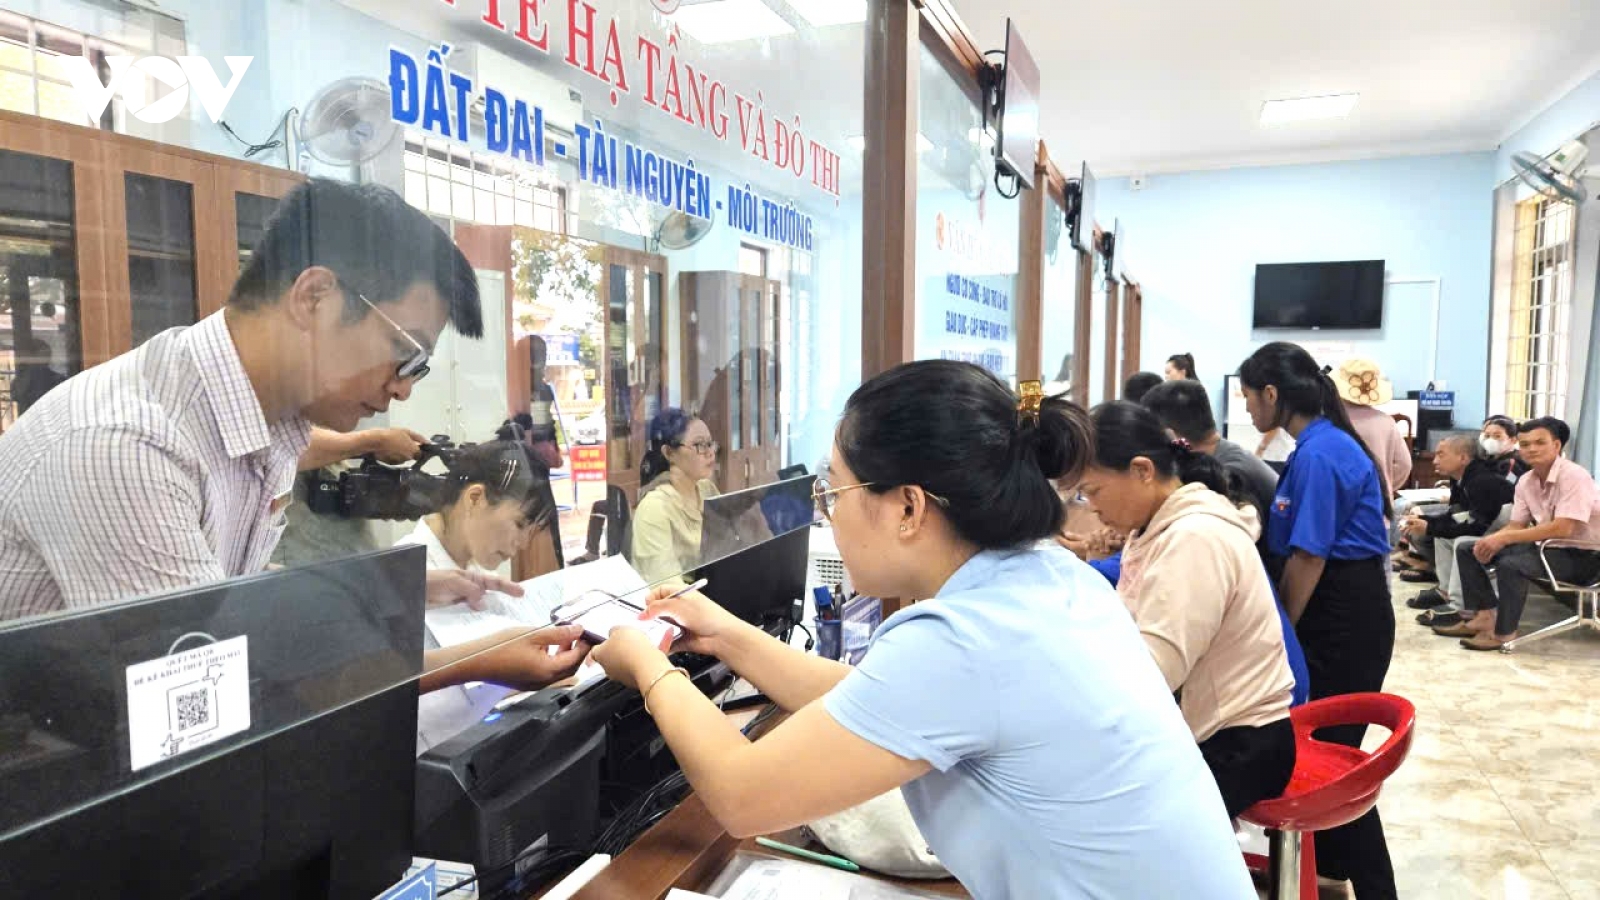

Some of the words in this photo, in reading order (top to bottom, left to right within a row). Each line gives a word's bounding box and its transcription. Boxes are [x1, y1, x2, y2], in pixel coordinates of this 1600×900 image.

[388, 44, 472, 143] ĐẤT
[485, 86, 543, 166] ĐAI
[575, 119, 618, 190] TÀI
[625, 143, 711, 220] NGUYÊN
[728, 183, 759, 235] MÔI
[763, 199, 813, 251] TRƯỜNG
[565, 0, 629, 106] HẠ
[638, 21, 729, 141] TẦNG
[735, 89, 769, 161] VÀ
[774, 115, 805, 177] ĐÔ
[810, 140, 841, 208] THỊ
